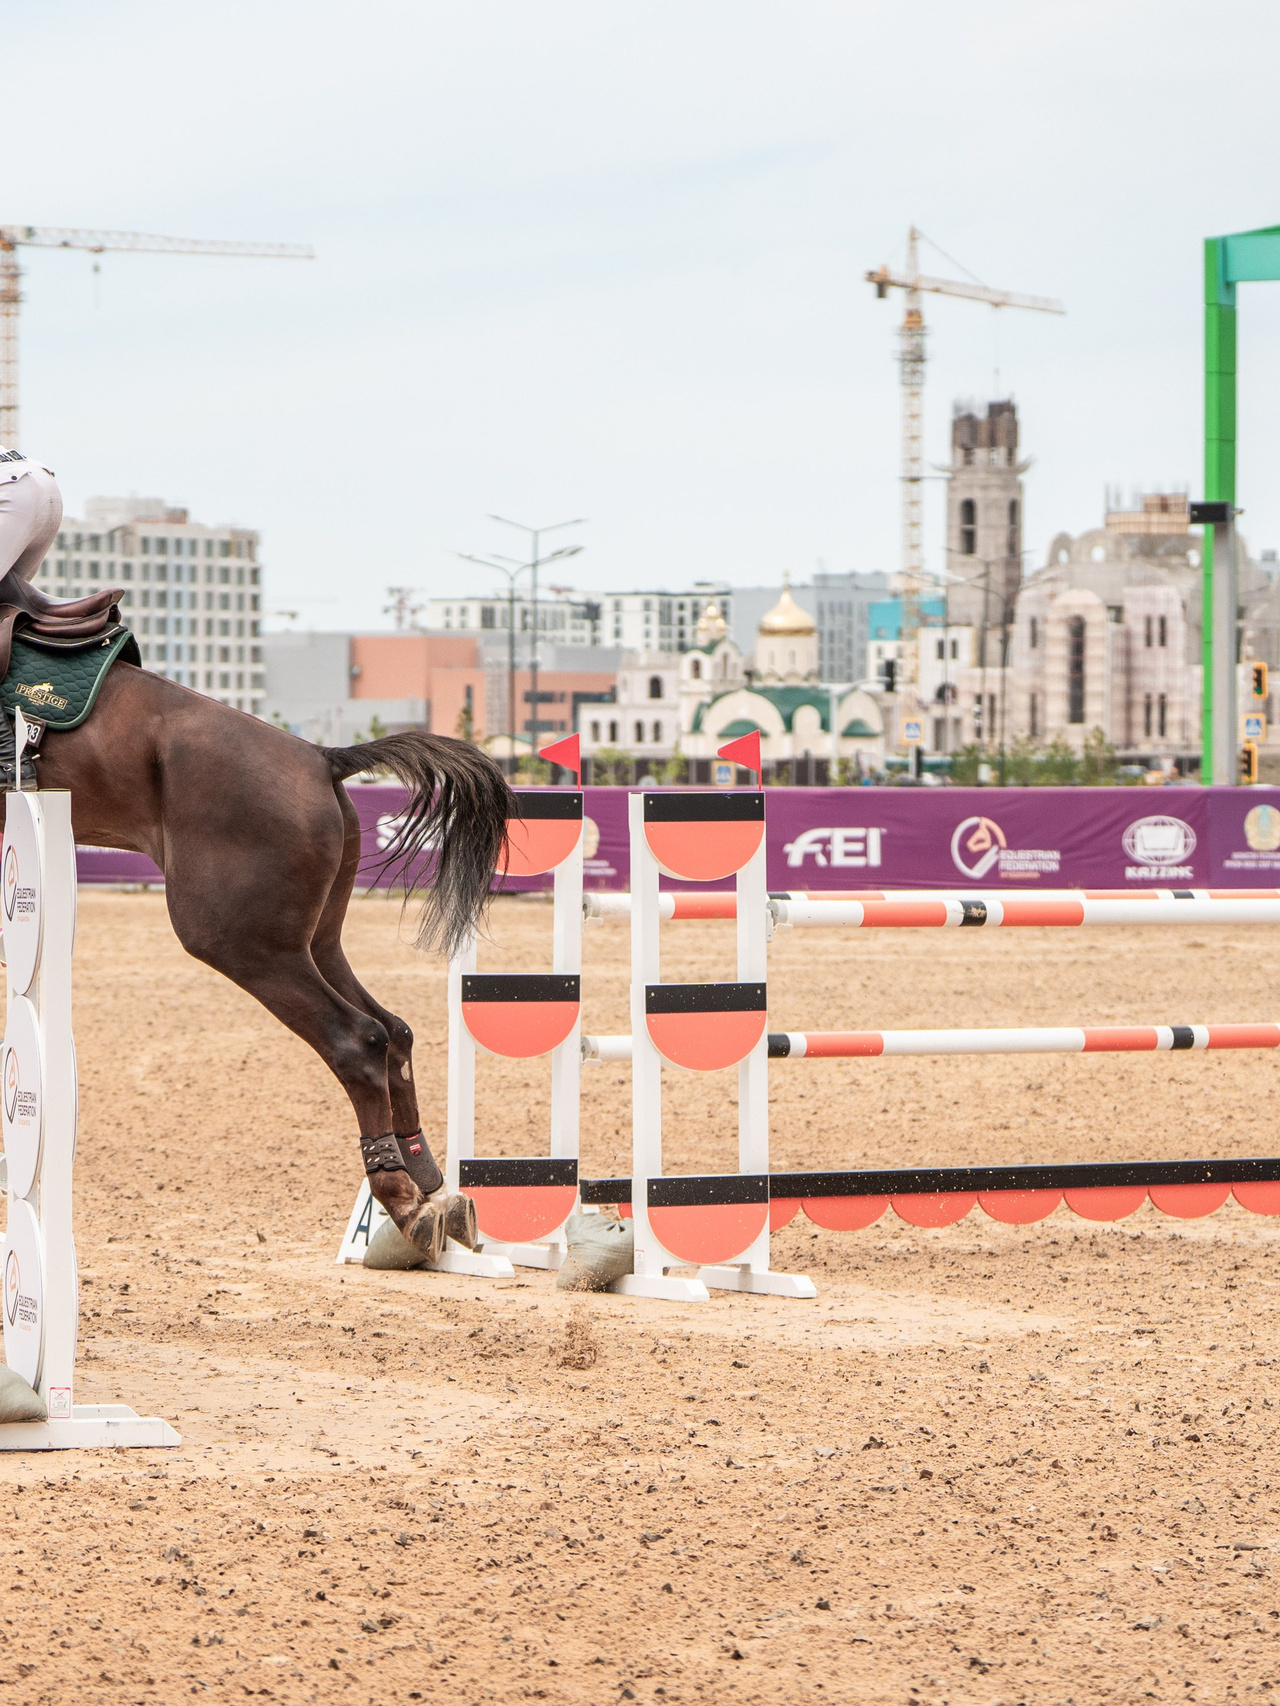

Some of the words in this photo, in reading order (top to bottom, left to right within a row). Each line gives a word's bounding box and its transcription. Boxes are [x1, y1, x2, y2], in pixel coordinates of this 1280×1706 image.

[18, 685, 65, 709] PRESTIGE
[783, 827, 881, 867] FEI
[351, 1192, 373, 1246] A
